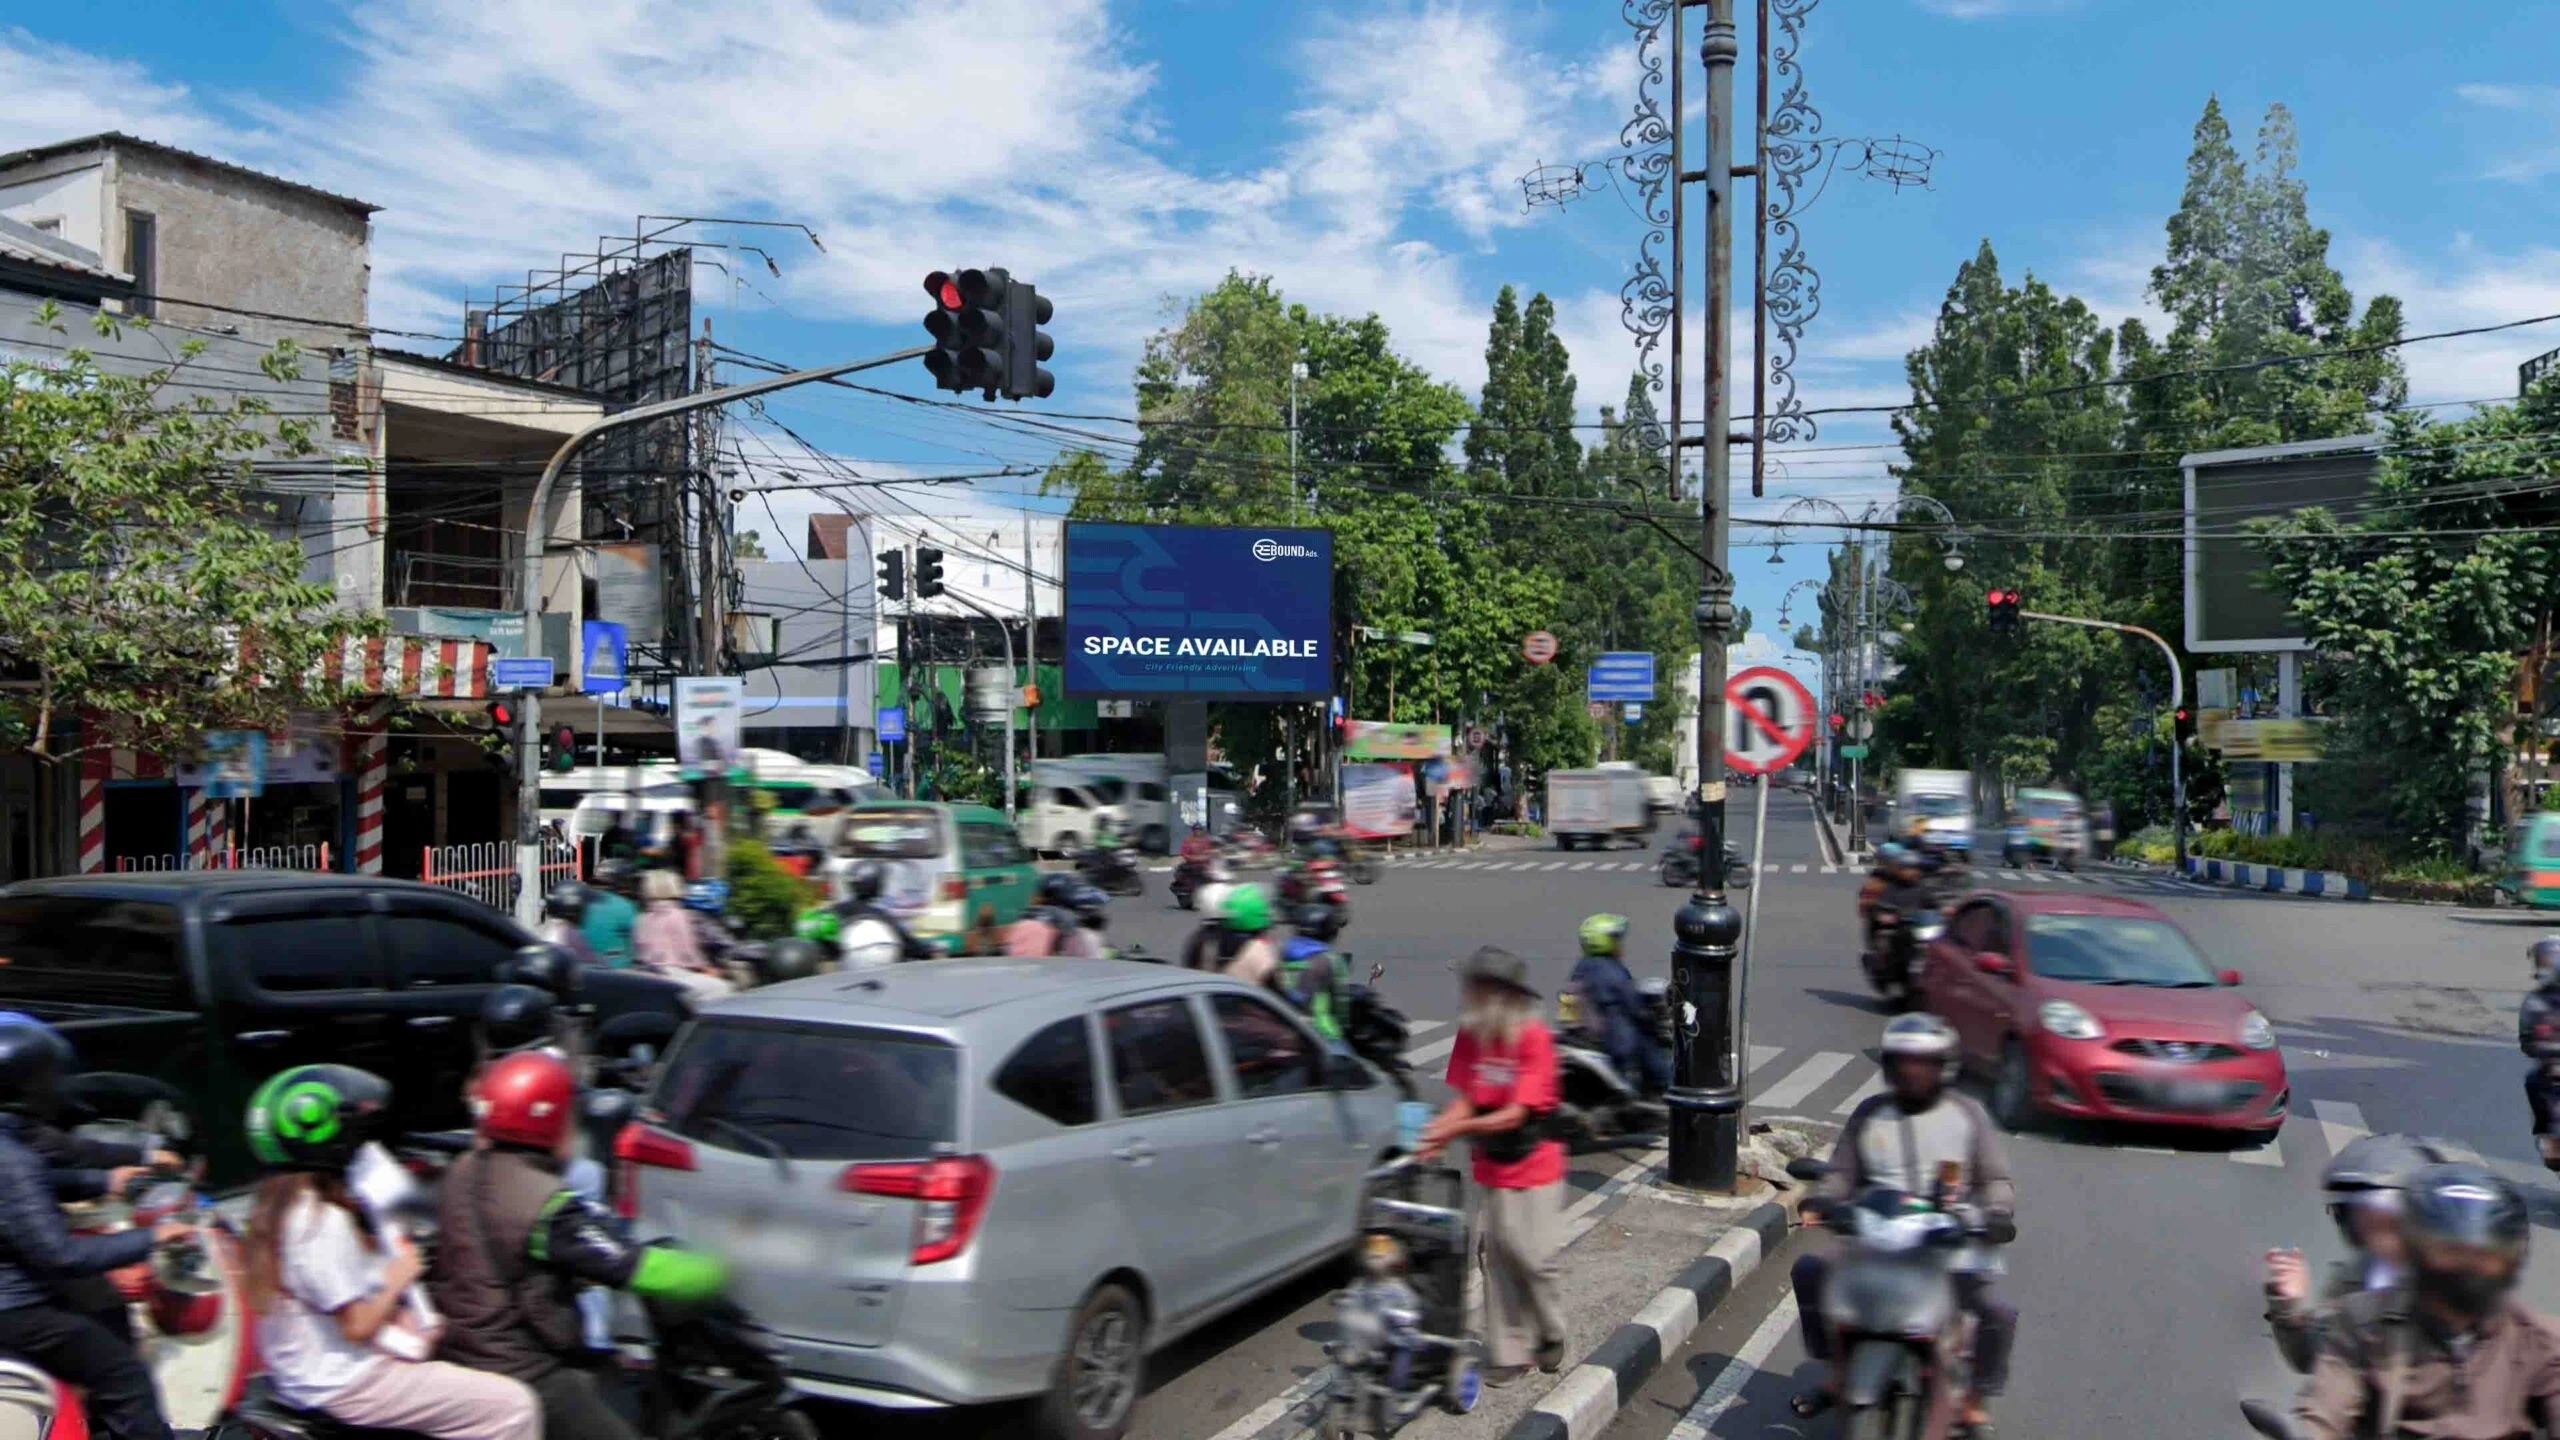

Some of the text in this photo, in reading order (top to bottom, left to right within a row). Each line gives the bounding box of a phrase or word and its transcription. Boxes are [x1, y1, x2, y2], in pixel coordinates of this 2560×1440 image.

[1253, 543, 1305, 558] REBOUND
[1083, 636, 1318, 657] SPACE AVAILABLE
[1144, 663, 1258, 673] City Friendly Advertising
